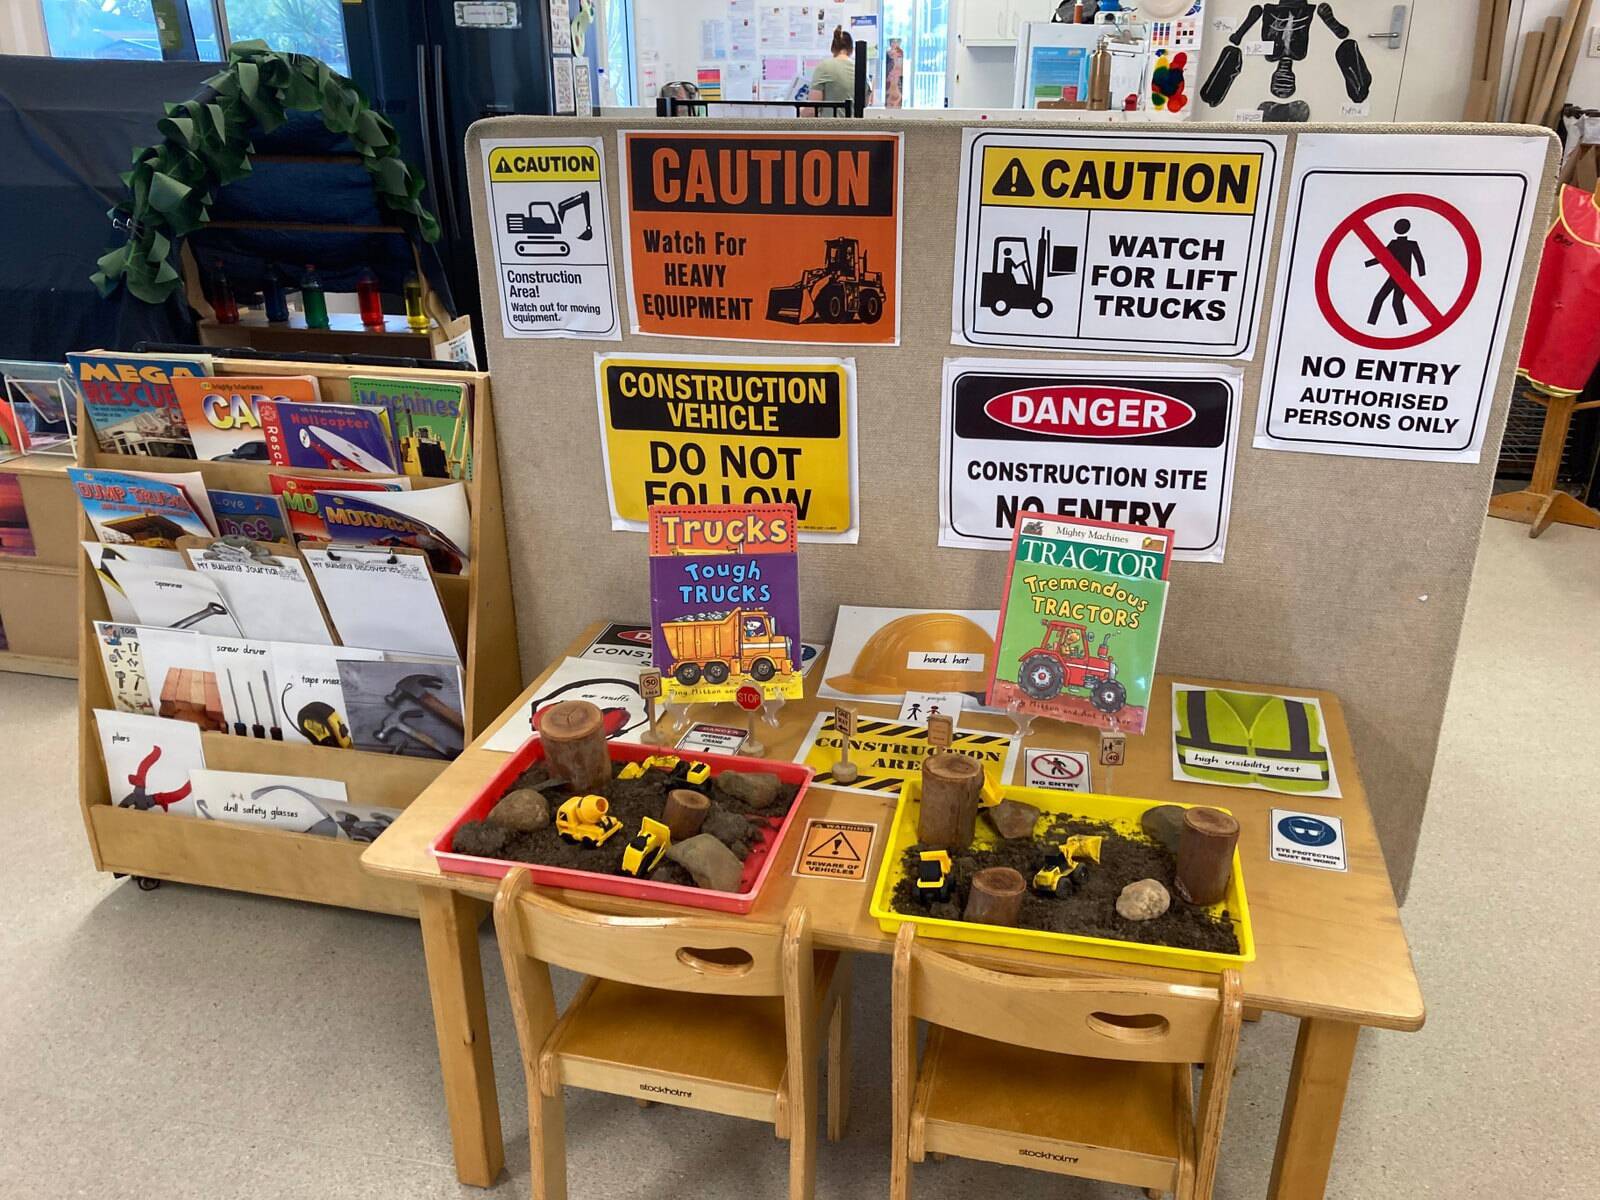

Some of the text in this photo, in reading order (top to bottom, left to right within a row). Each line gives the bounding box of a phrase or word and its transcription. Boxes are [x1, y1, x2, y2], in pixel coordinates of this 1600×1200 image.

[513, 155, 595, 173] CAUTION
[652, 148, 870, 207] CAUTION
[1041, 159, 1250, 203] CAUTION
[643, 229, 747, 257] Watch For
[1109, 235, 1224, 260] WATCH
[507, 270, 582, 284] Construction
[664, 263, 726, 288] HEAVY
[1091, 265, 1237, 291] FOR LIFT
[509, 285, 540, 298] Area!
[511, 302, 601, 317] Watch out for moving
[513, 313, 562, 325] equipment.
[643, 294, 753, 321] EQUIPMENT
[1094, 295, 1226, 321] TRUCKS
[1301, 356, 1460, 385] NO ENTRY
[619, 372, 826, 404] CONSTRUCTION
[1299, 387, 1448, 411] AUTHORISED
[359, 390, 461, 417] Machines
[1011, 396, 1168, 428] DANGER
[290, 413, 369, 430] Helicopter
[667, 402, 779, 431] VEHICLE
[1284, 408, 1459, 434] PERSONS ONLY
[650, 441, 802, 480] DO NOT
[967, 460, 1207, 490] CONSTRUCTION SITE
[996, 495, 1176, 529] NO ENTRY
[662, 516, 788, 544] Trucks
[1056, 525, 1129, 543] Mighty Machines
[685, 560, 761, 583] Tough
[1021, 539, 1158, 580] TRACTOR
[679, 584, 771, 604] TRUCKS
[1023, 575, 1149, 612] Tremendous
[1032, 595, 1140, 629] TRACTORS
[923, 654, 970, 665] hard hat
[302, 675, 319, 687] tape
[737, 692, 760, 704] STOP
[703, 727, 740, 735] DANGER
[1194, 753, 1301, 774] high visibility vest
[223, 802, 299, 820] drill safety glasses
[1292, 849, 1341, 860] PROTECTION
[808, 866, 855, 875] VEHICLES
